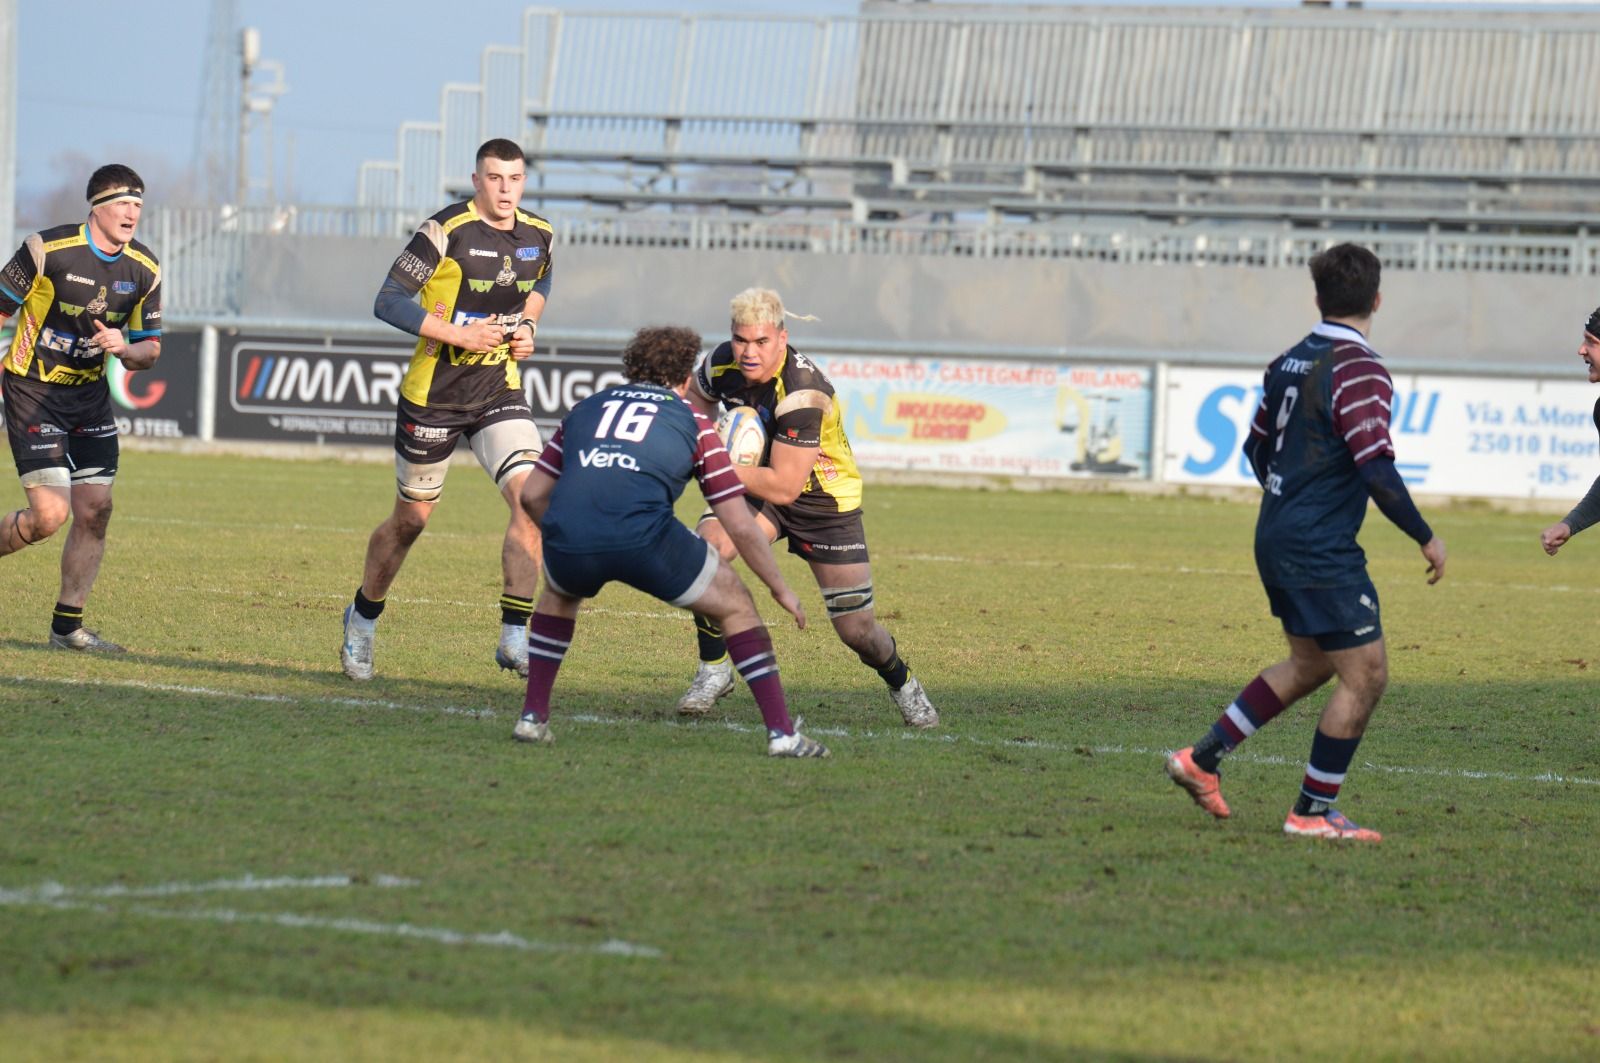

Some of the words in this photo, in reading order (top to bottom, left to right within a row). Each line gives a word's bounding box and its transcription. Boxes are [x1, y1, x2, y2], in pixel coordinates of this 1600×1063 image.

[829, 361, 924, 382] CALCINATO
[939, 364, 1057, 387] CASTEGNATO
[1071, 369, 1141, 390] MILANO
[594, 400, 659, 443] 16
[1464, 400, 1503, 425] Via
[133, 417, 183, 438] STEEL
[414, 425, 448, 438] SPIDER
[1468, 431, 1542, 455] 25010
